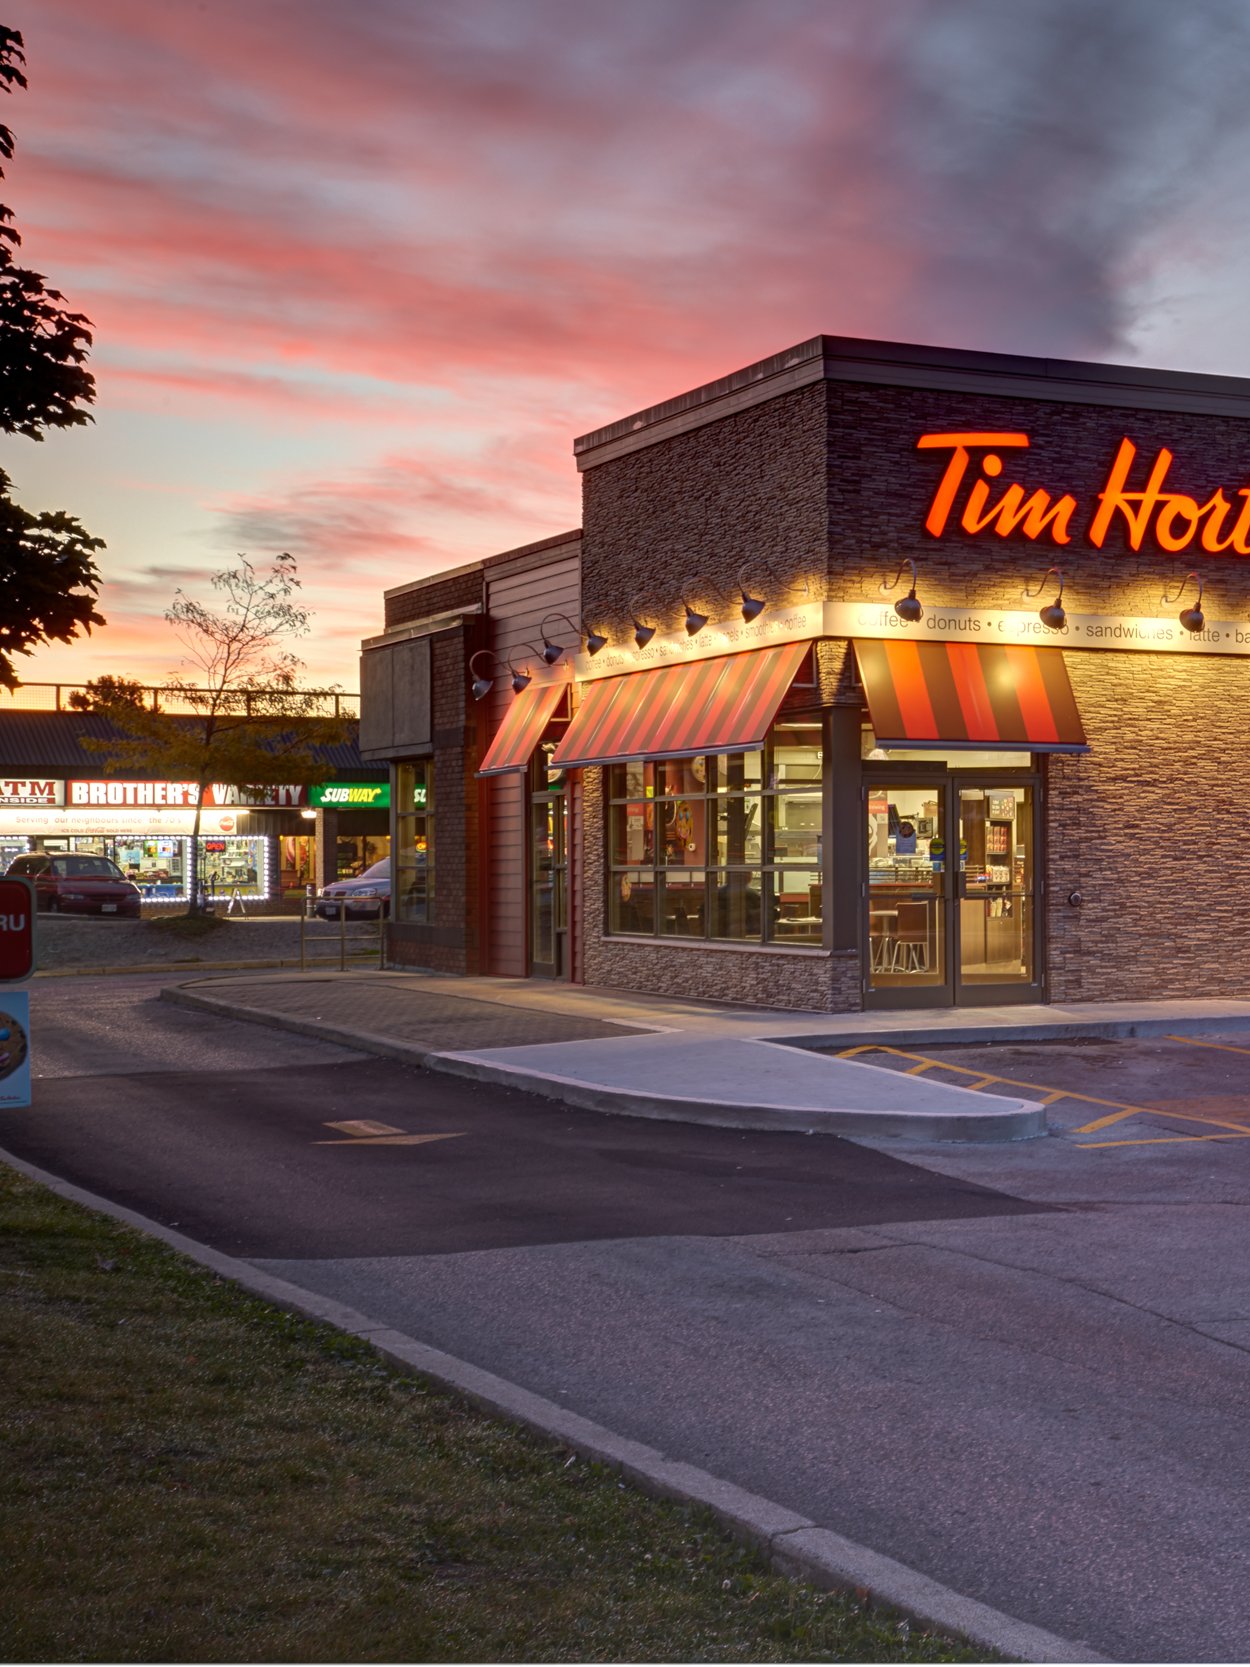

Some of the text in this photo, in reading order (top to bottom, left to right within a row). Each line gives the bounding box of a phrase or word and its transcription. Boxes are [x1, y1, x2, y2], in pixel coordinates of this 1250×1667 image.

[917, 432, 1077, 545] Tim
[927, 614, 981, 632] donuts
[72, 782, 199, 804] BROTHER'S
[320, 787, 382, 803] SUBWAY
[206, 842, 225, 850] OPEN
